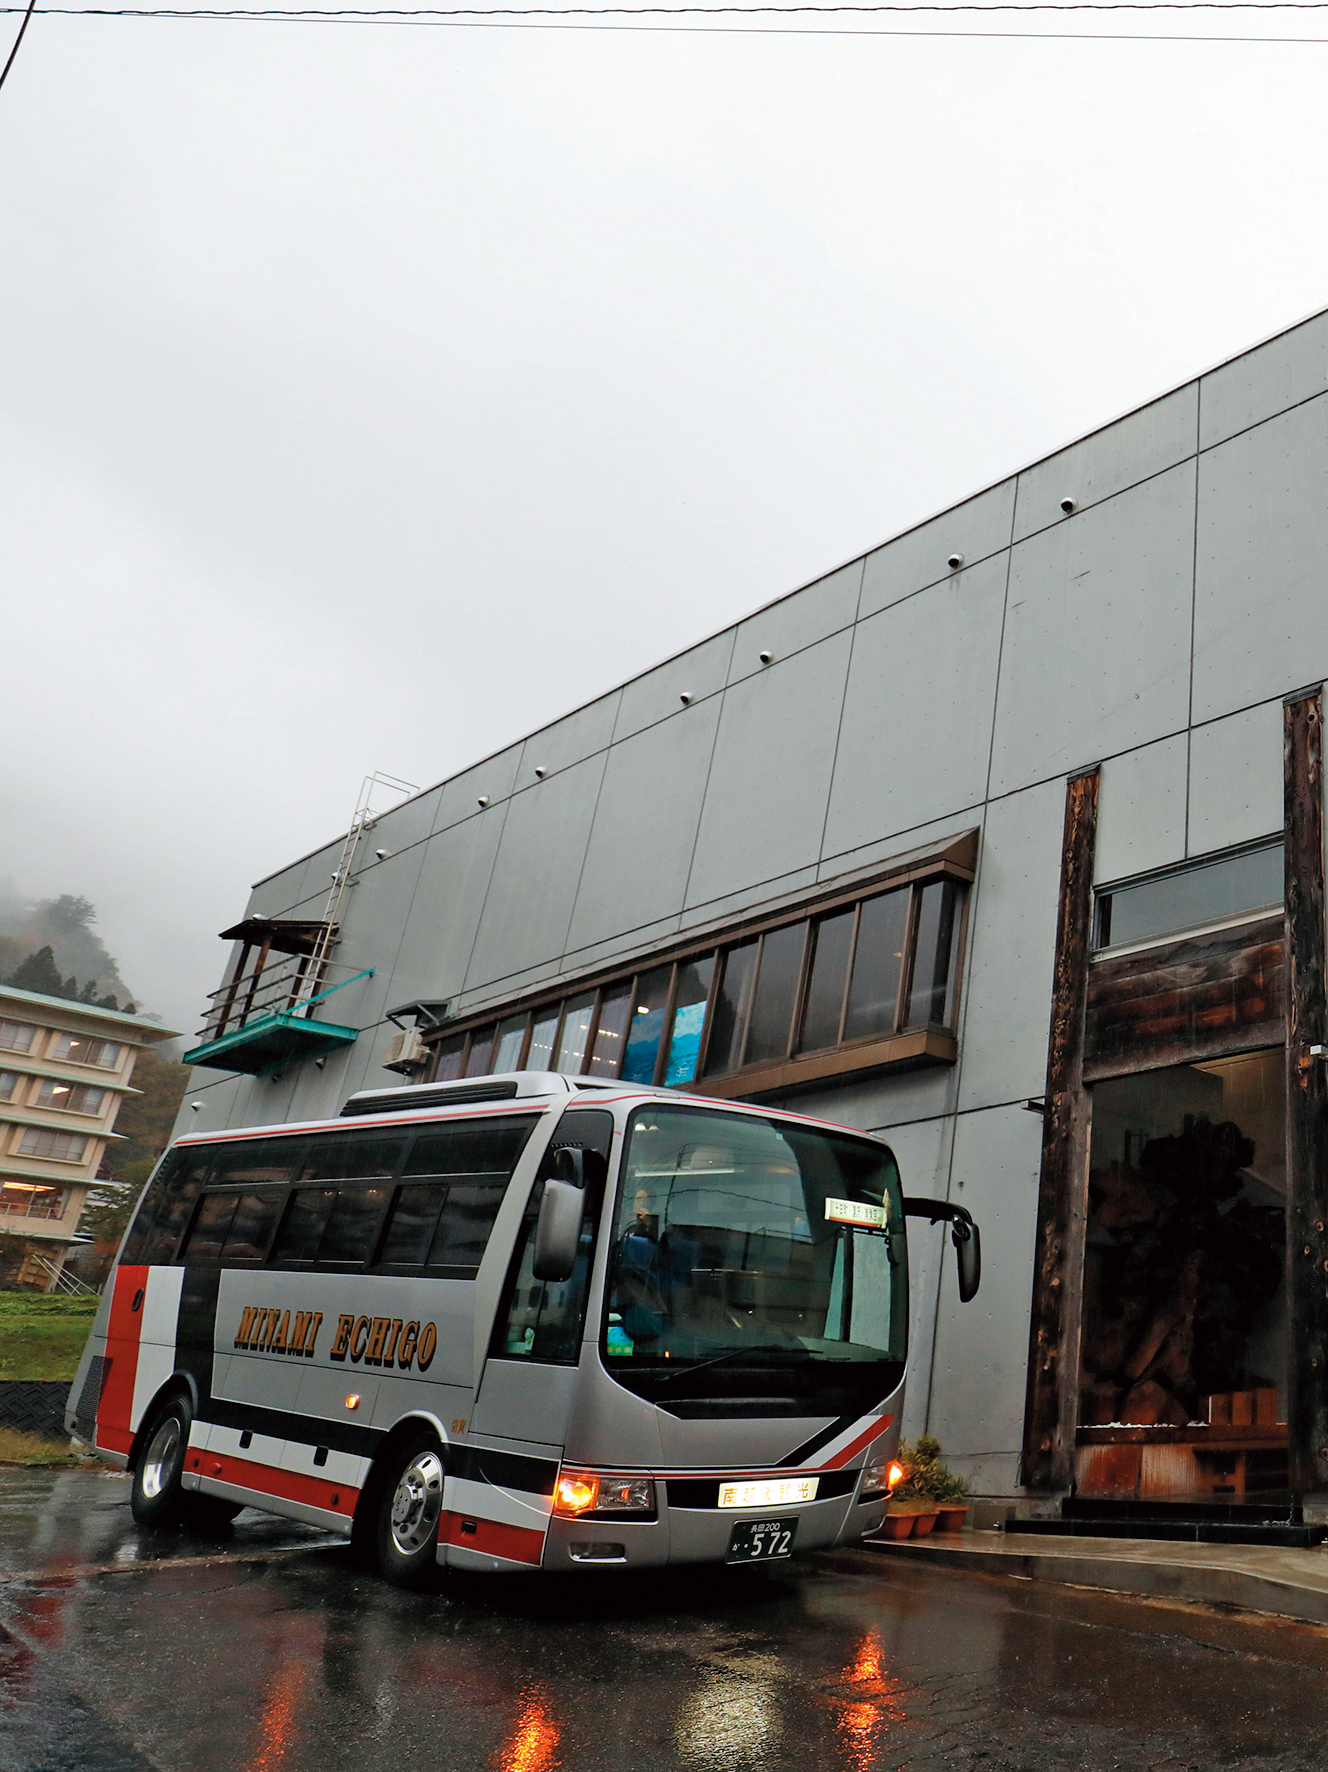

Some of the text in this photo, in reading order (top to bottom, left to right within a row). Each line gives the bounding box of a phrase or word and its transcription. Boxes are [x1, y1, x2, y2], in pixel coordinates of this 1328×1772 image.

[234, 1306, 438, 1372] MINAMI ECHIGO
[723, 1482, 809, 1505] 南越後観光
